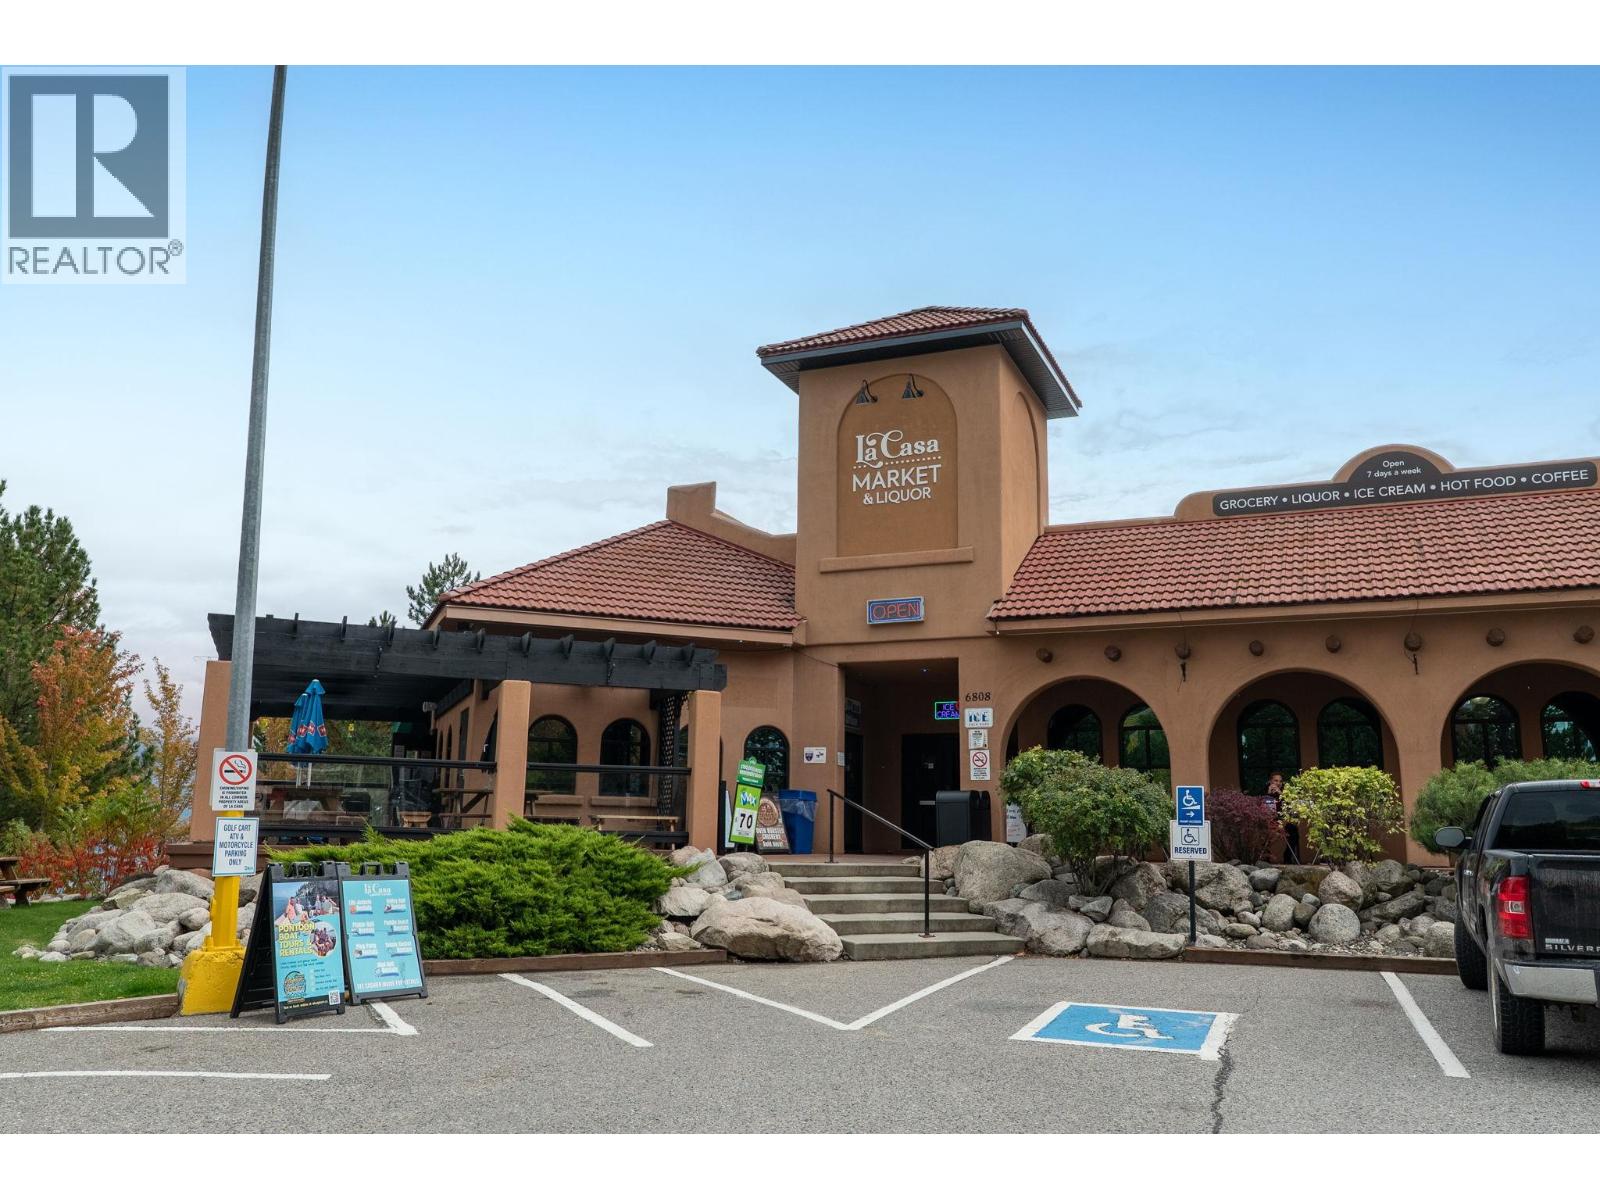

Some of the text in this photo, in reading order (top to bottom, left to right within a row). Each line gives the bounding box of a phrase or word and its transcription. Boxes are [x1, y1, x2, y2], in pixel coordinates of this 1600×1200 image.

[855, 429, 940, 468] La Casa
[1382, 460, 1405, 468] Open
[852, 463, 942, 492] MARKET
[1367, 470, 1373, 478] 7
[1374, 469, 1392, 479] days
[1400, 466, 1422, 475] week
[863, 486, 931, 504] & LIQUOR
[1219, 469, 1590, 511] GROCERY LIQUOR ICE CREAM HOT FOOD COFFEE
[872, 602, 920, 620] OPEN
[965, 691, 991, 702] 6808
[943, 703, 955, 711] ICE
[968, 711, 990, 723] ICE
[740, 813, 753, 829] 70
[223, 824, 251, 832] GOLF CART
[219, 841, 254, 849] MOTORCYCLE
[1174, 846, 1207, 854] RESERVED
[228, 858, 242, 866] ONLY
[278, 922, 315, 933] PONTOON
[280, 941, 304, 949] TOURS
